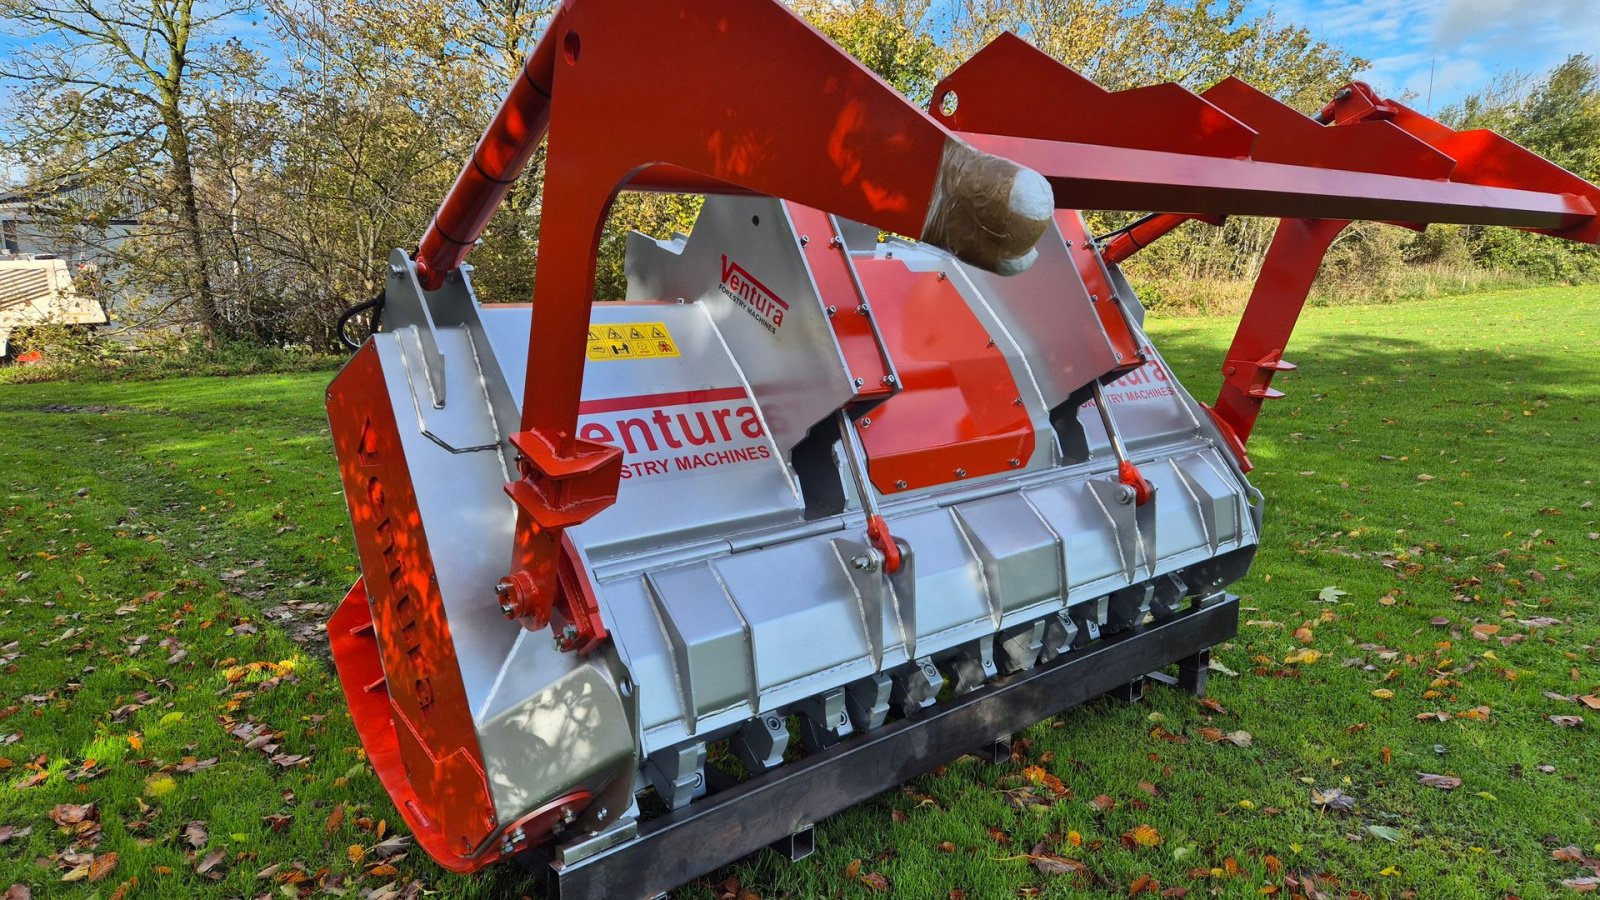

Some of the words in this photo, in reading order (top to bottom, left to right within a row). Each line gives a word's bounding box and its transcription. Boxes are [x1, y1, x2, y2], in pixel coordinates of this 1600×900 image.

[718, 283, 747, 309] FORESTRY
[746, 307, 777, 335] MACHINES
[720, 253, 788, 328] Ventura
[1125, 386, 1175, 402] MACHINES
[580, 404, 765, 454] entura
[620, 458, 670, 480] STRY
[674, 445, 771, 472] MACHINES
